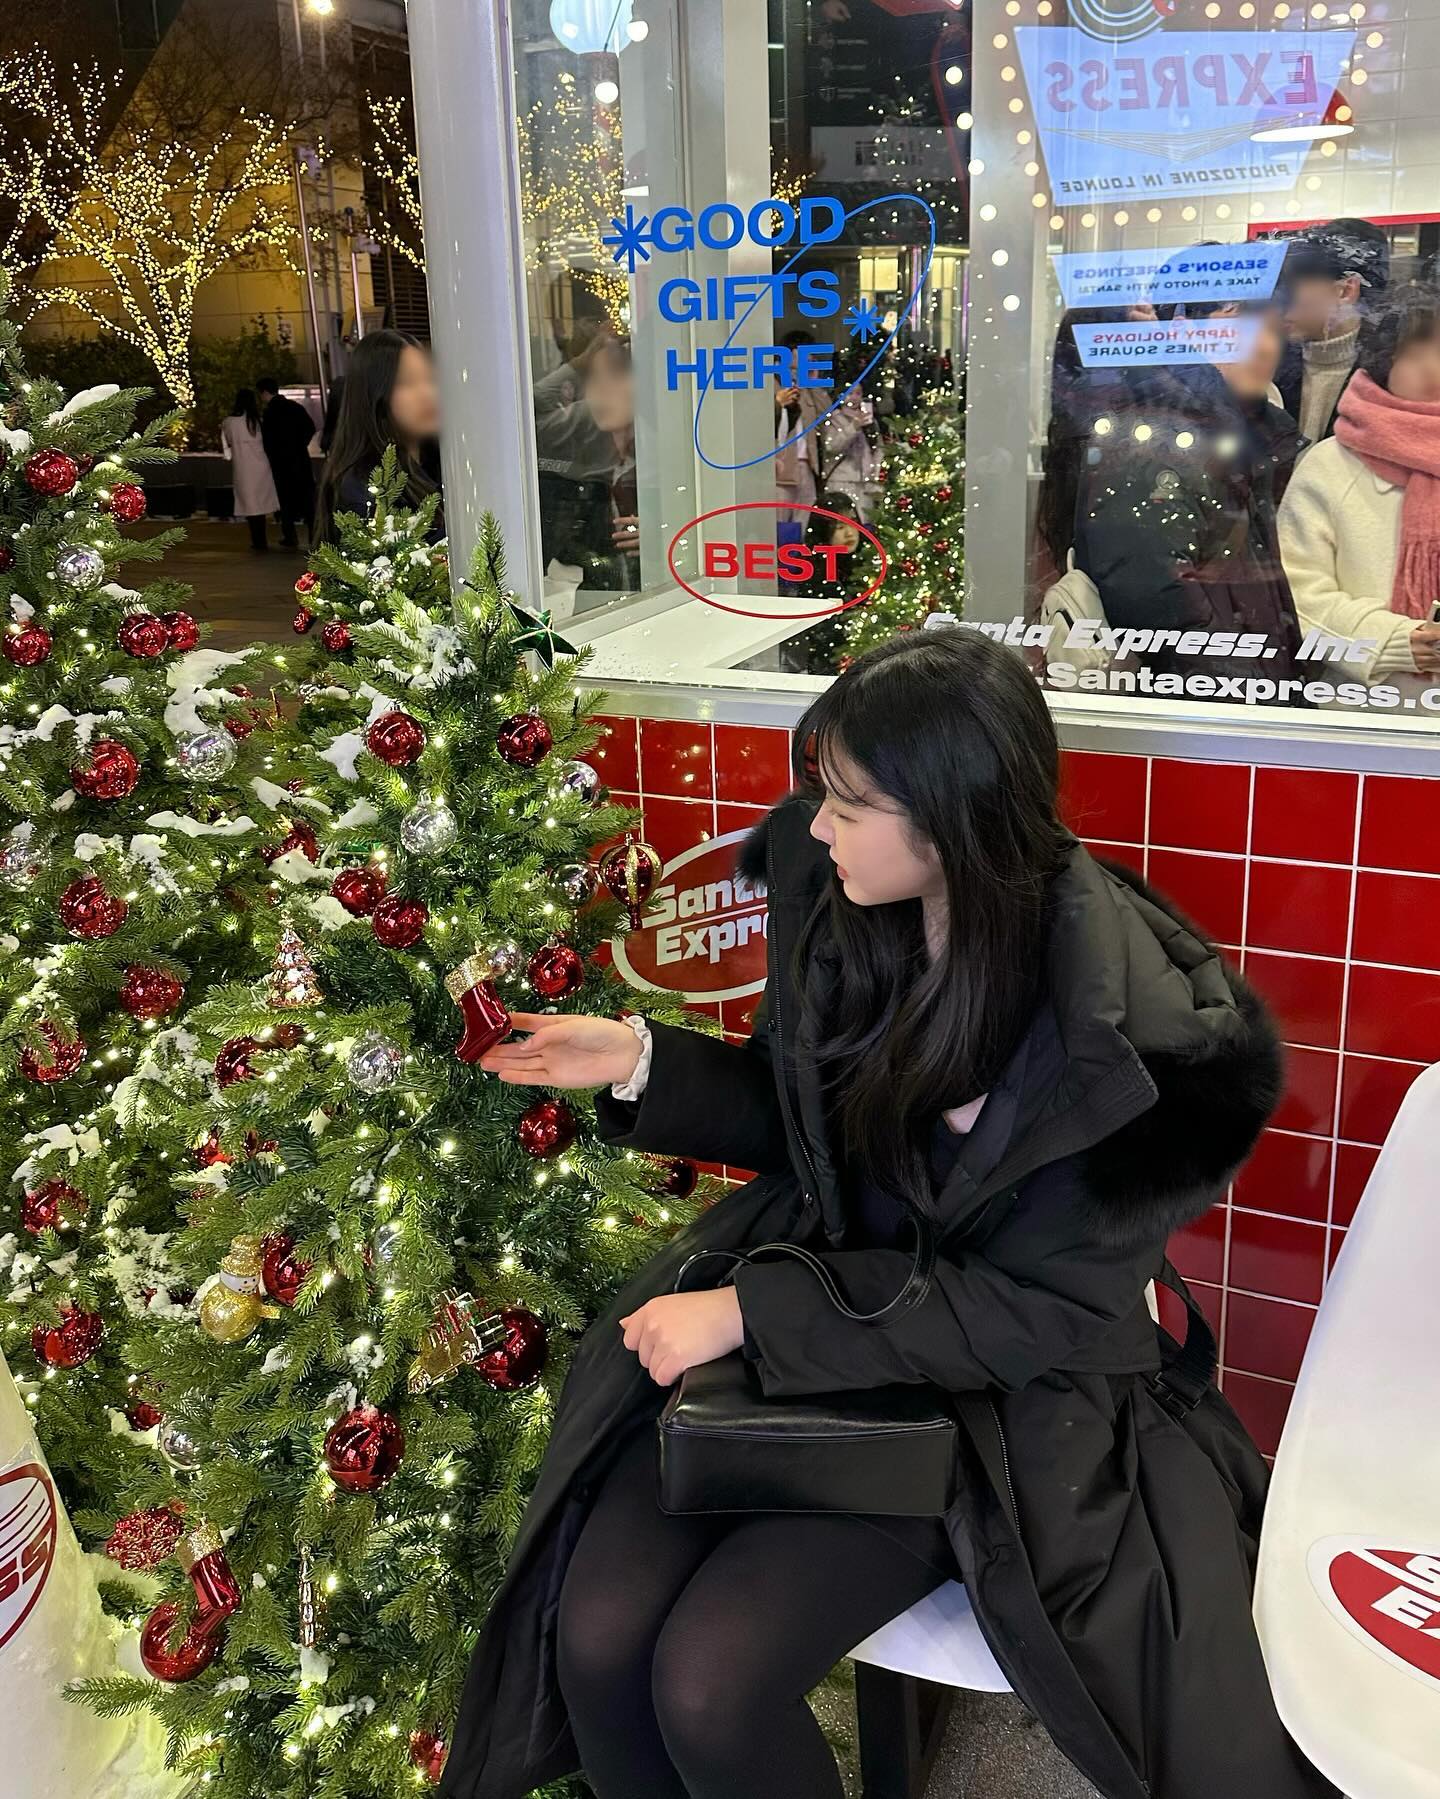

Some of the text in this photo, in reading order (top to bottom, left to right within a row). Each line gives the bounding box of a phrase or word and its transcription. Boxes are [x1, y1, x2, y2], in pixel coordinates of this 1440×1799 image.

[650, 196, 846, 253] GOOD
[658, 271, 841, 323] GIFTS
[666, 344, 835, 391] HERE
[704, 543, 849, 583] BEST
[1062, 617, 1278, 660] Express.
[1030, 661, 1440, 711] .Santaexpress.c
[657, 911, 768, 966] Expr
